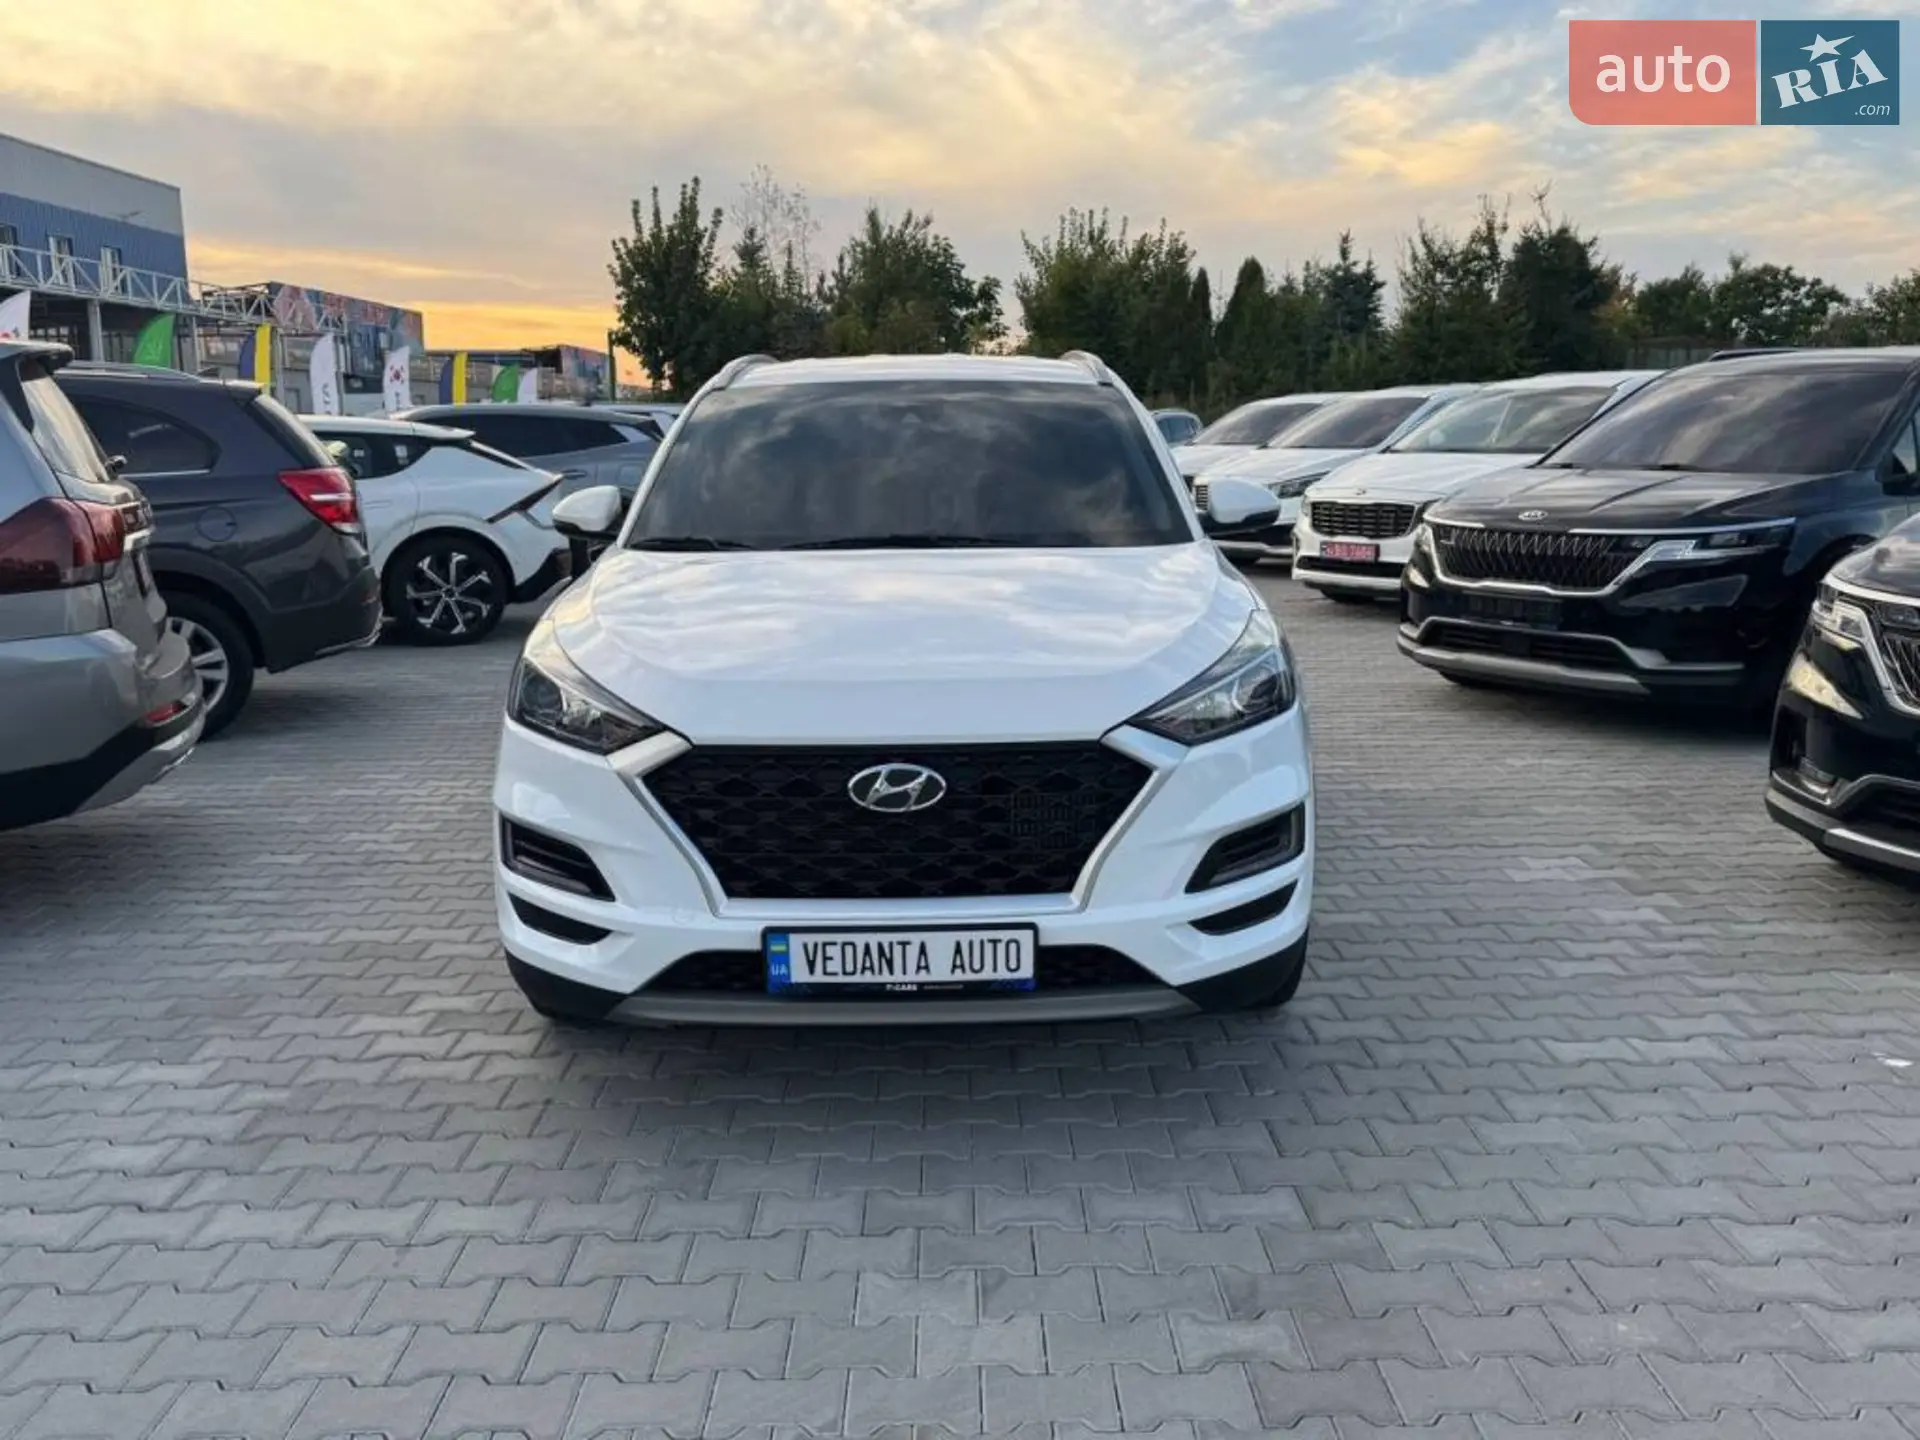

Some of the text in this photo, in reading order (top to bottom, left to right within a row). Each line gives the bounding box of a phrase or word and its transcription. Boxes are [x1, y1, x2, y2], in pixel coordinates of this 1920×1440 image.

[771, 963, 788, 976] UA
[802, 938, 1021, 976] VEDANTA AUTO
